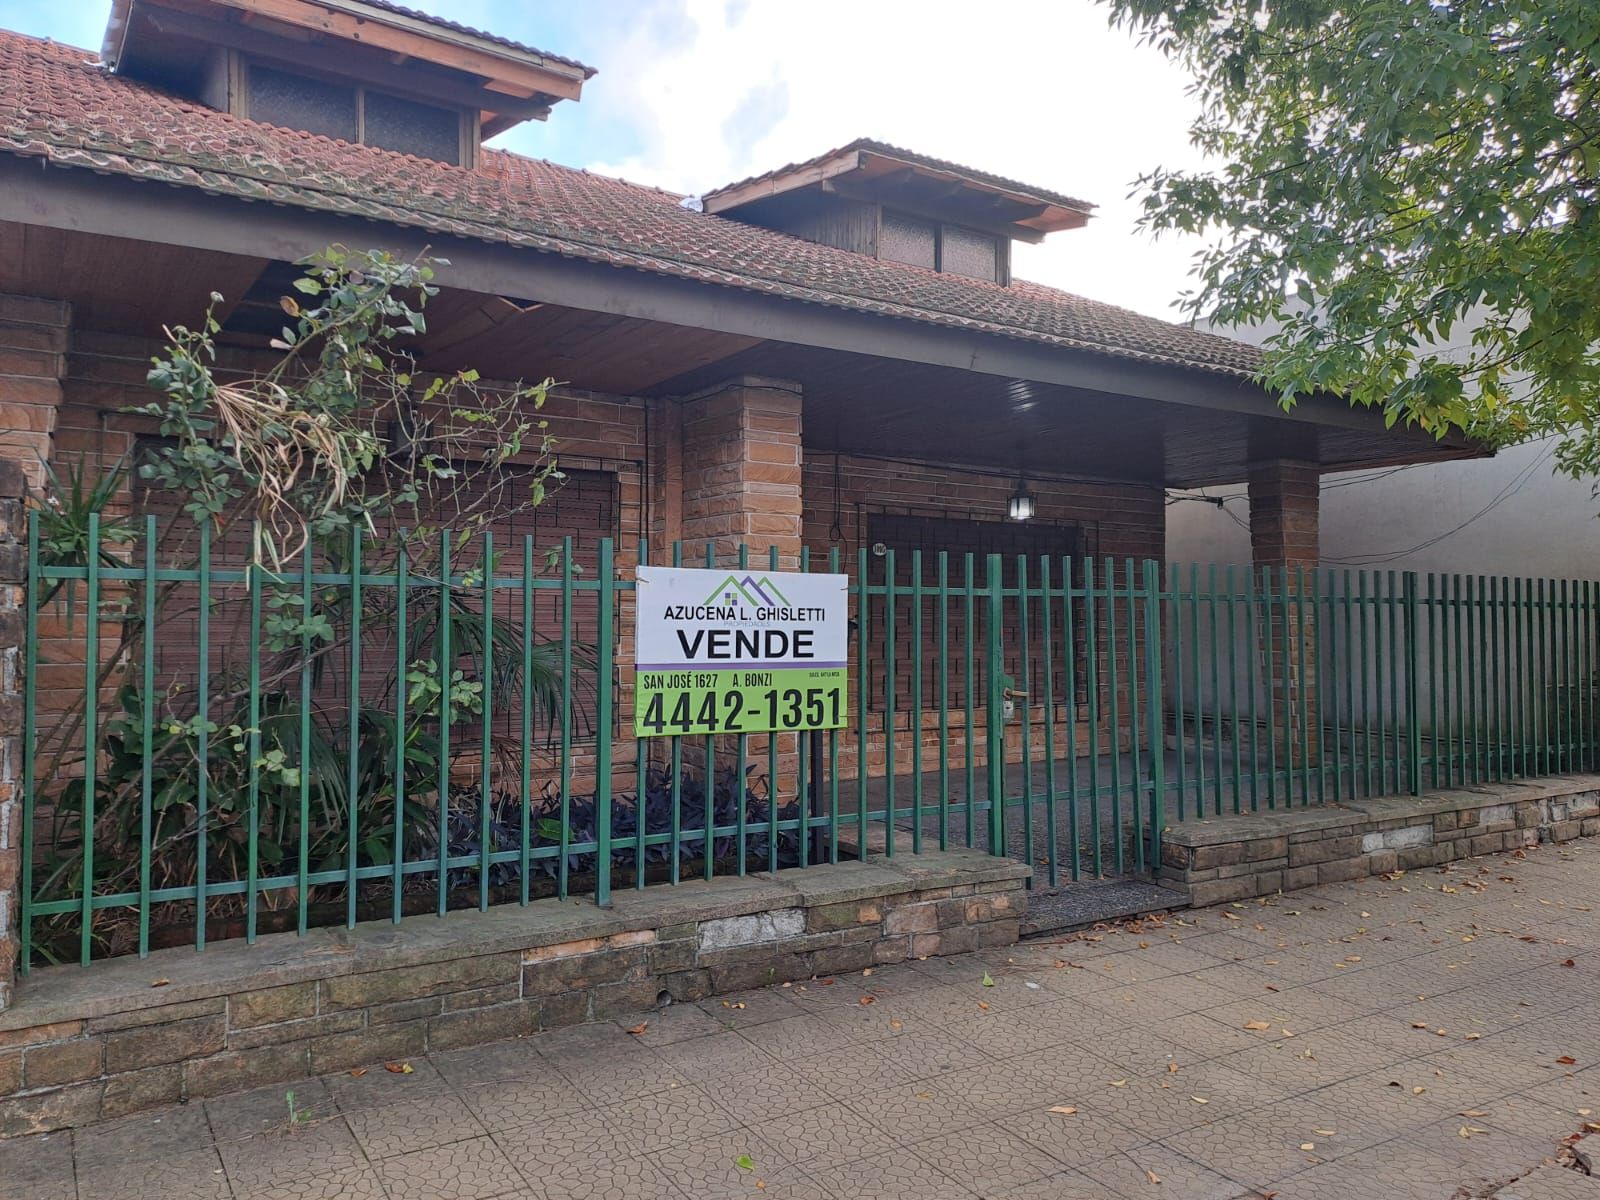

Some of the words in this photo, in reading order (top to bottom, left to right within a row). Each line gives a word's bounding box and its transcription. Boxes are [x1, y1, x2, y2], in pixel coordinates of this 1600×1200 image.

[663, 605, 736, 621] AZUCENA
[740, 607, 752, 621] L.
[756, 607, 825, 621] GHISLETTI
[676, 629, 814, 659] VENDE
[643, 674, 664, 689] SAN
[667, 671, 692, 689] JOSÉ
[694, 673, 718, 688] 1627
[732, 673, 742, 688] A.
[745, 673, 773, 687] BONZI
[642, 687, 840, 734] 4442-1351
